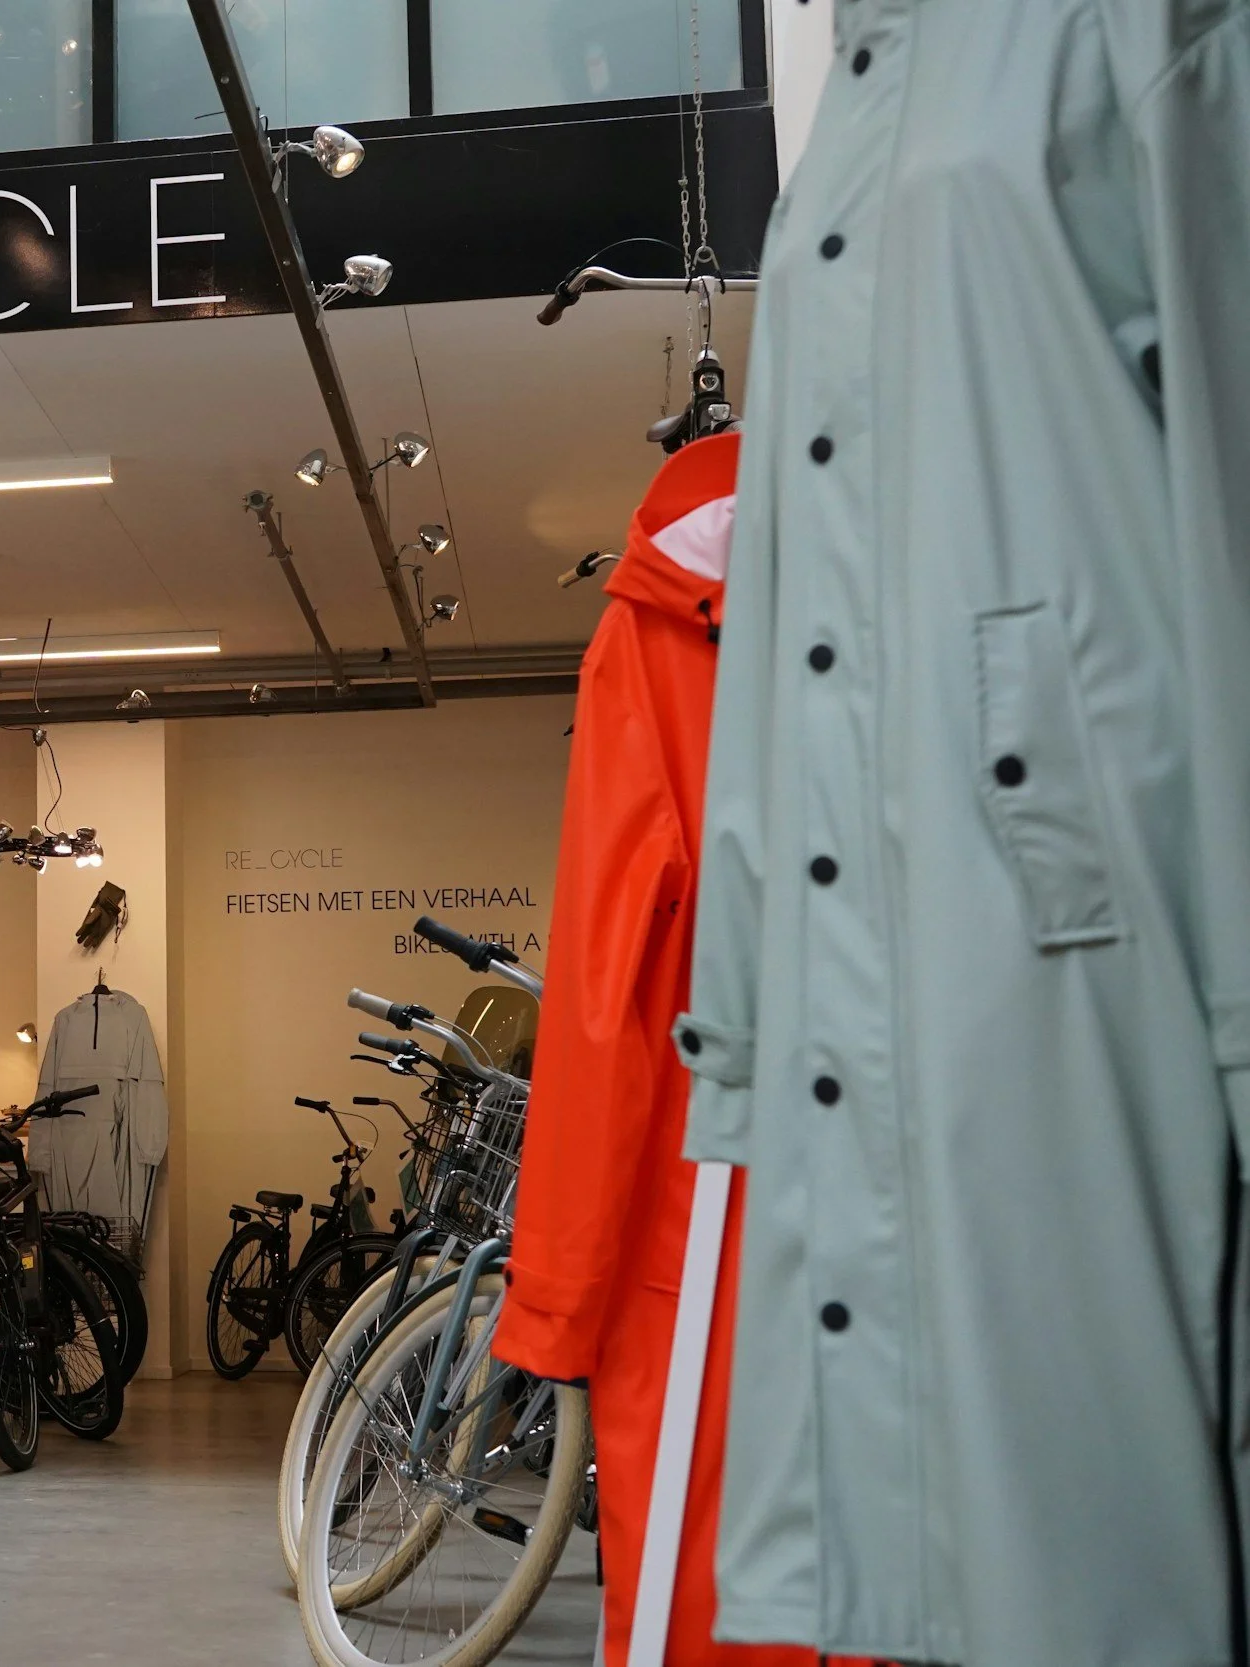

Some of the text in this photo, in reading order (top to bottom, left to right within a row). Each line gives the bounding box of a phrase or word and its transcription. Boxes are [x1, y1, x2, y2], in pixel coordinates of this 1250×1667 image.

[226, 887, 537, 914] FIETSEN MET EEN VERHAAL
[522, 932, 542, 952] A
